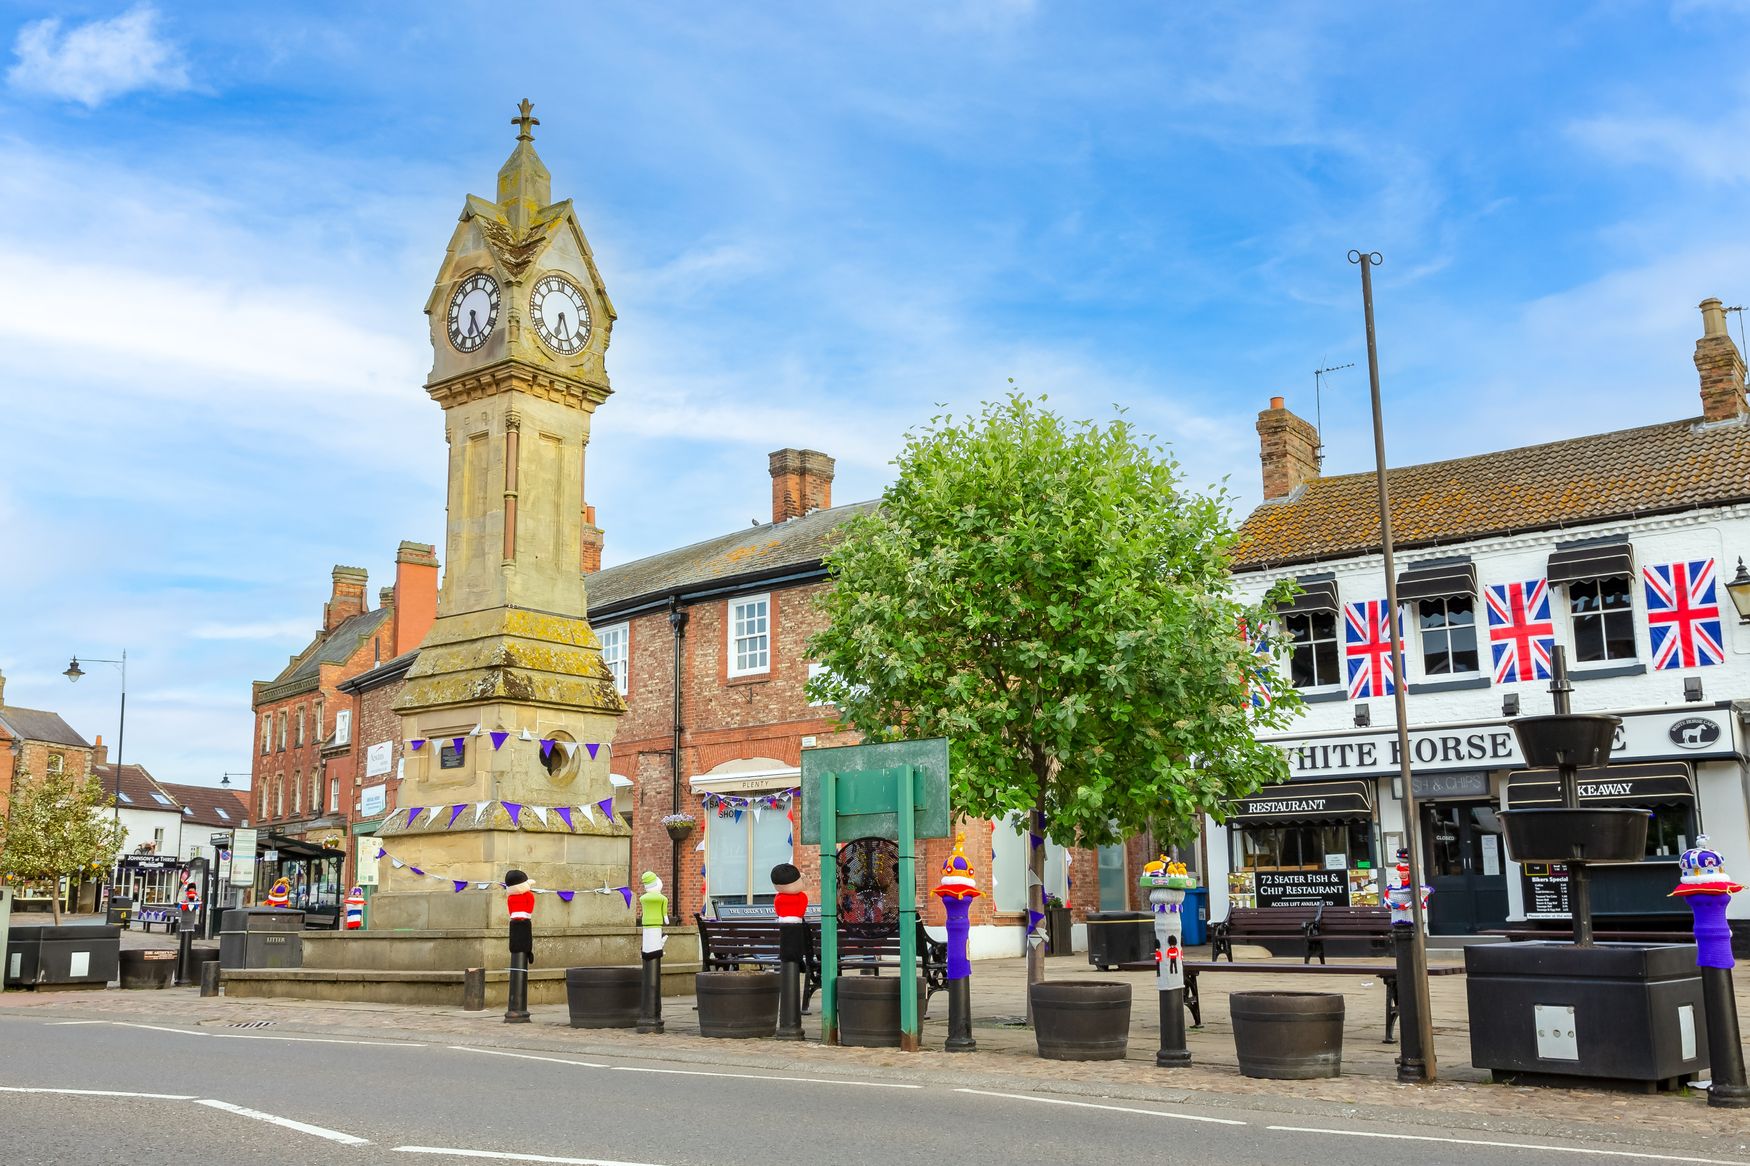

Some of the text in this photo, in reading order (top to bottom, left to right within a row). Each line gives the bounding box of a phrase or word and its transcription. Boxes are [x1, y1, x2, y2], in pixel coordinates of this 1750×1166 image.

[1389, 733, 1512, 764] HORSE
[1558, 783, 1633, 797] KEAWAY
[1248, 800, 1326, 813] RESTAURANT
[1261, 874, 1339, 884] 72 SEATER FISH &
[1260, 886, 1343, 895] CHIP RESTAURANT
